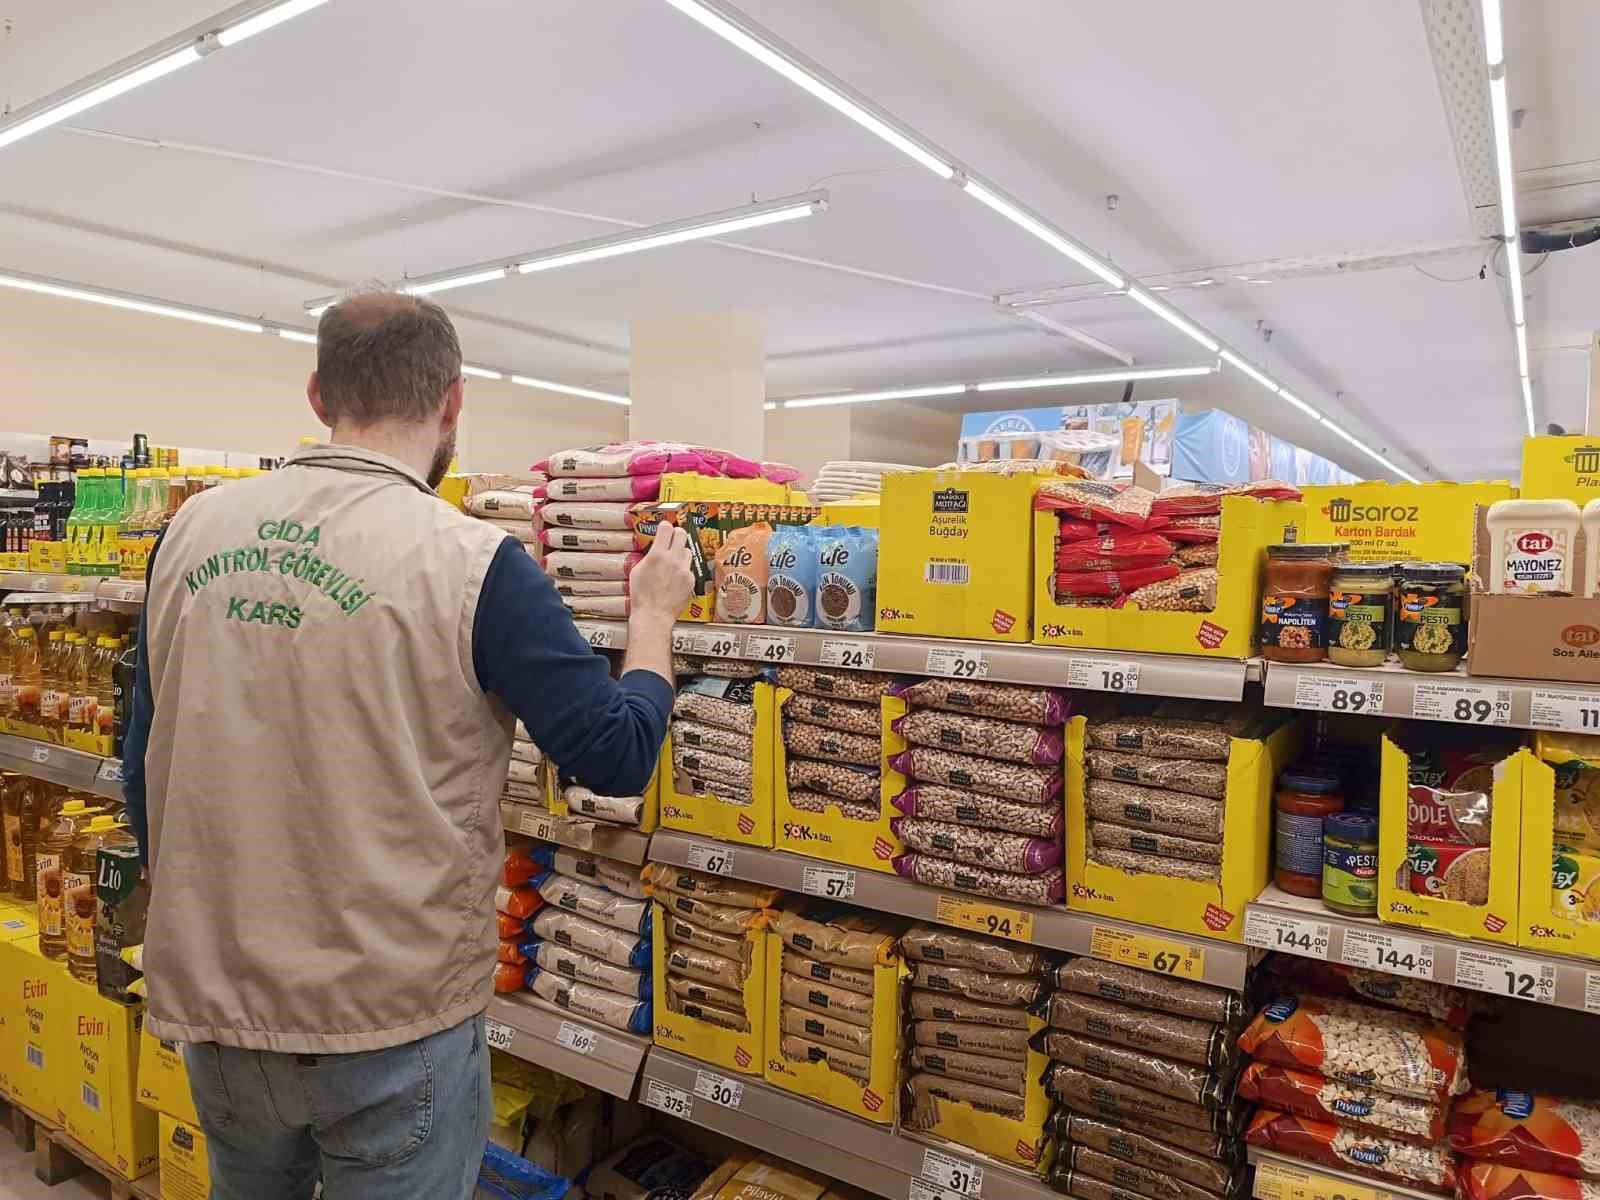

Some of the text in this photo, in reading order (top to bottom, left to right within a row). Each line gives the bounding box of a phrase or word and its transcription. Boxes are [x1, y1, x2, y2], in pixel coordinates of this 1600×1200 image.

[1576, 477, 1600, 487] Pla
[1352, 505, 1419, 522] saroz
[258, 519, 321, 547] GIDA
[929, 526, 969, 540] Buğday
[1335, 525, 1417, 538] Karton Bardak
[1521, 538, 1549, 550] tat
[186, 547, 272, 595] KONTROL
[1506, 559, 1563, 571] MAYONEZ
[226, 596, 305, 629] KARS
[1345, 612, 1373, 621] PESTO
[1420, 614, 1450, 625] PESTO
[711, 640, 732, 656] 49
[764, 644, 786, 661] 49
[1552, 648, 1600, 659] Sos Aile
[841, 650, 864, 667] 24
[952, 659, 977, 677] 29
[1101, 670, 1124, 690] 18
[1331, 689, 1367, 711] 89
[1454, 698, 1492, 722] 89
[1408, 803, 1447, 826] ODLE
[537, 823, 549, 838] 81
[706, 855, 725, 873] 67
[1348, 855, 1377, 867] PEST
[98, 857, 121, 891] Lio
[826, 878, 845, 897] 57
[1568, 894, 1577, 905] 3
[987, 914, 1012, 937] 94
[1276, 928, 1313, 951] 144
[1153, 951, 1181, 973] 67
[1376, 947, 1417, 972] 144
[23, 979, 48, 1000] Evin
[1504, 970, 1536, 999] 12
[77, 1015, 104, 1036] Evin
[488, 1028, 506, 1045] 330
[570, 1033, 589, 1050] 169
[711, 1084, 732, 1105] 30
[663, 1095, 684, 1113] 375
[950, 1169, 969, 1193] 31
